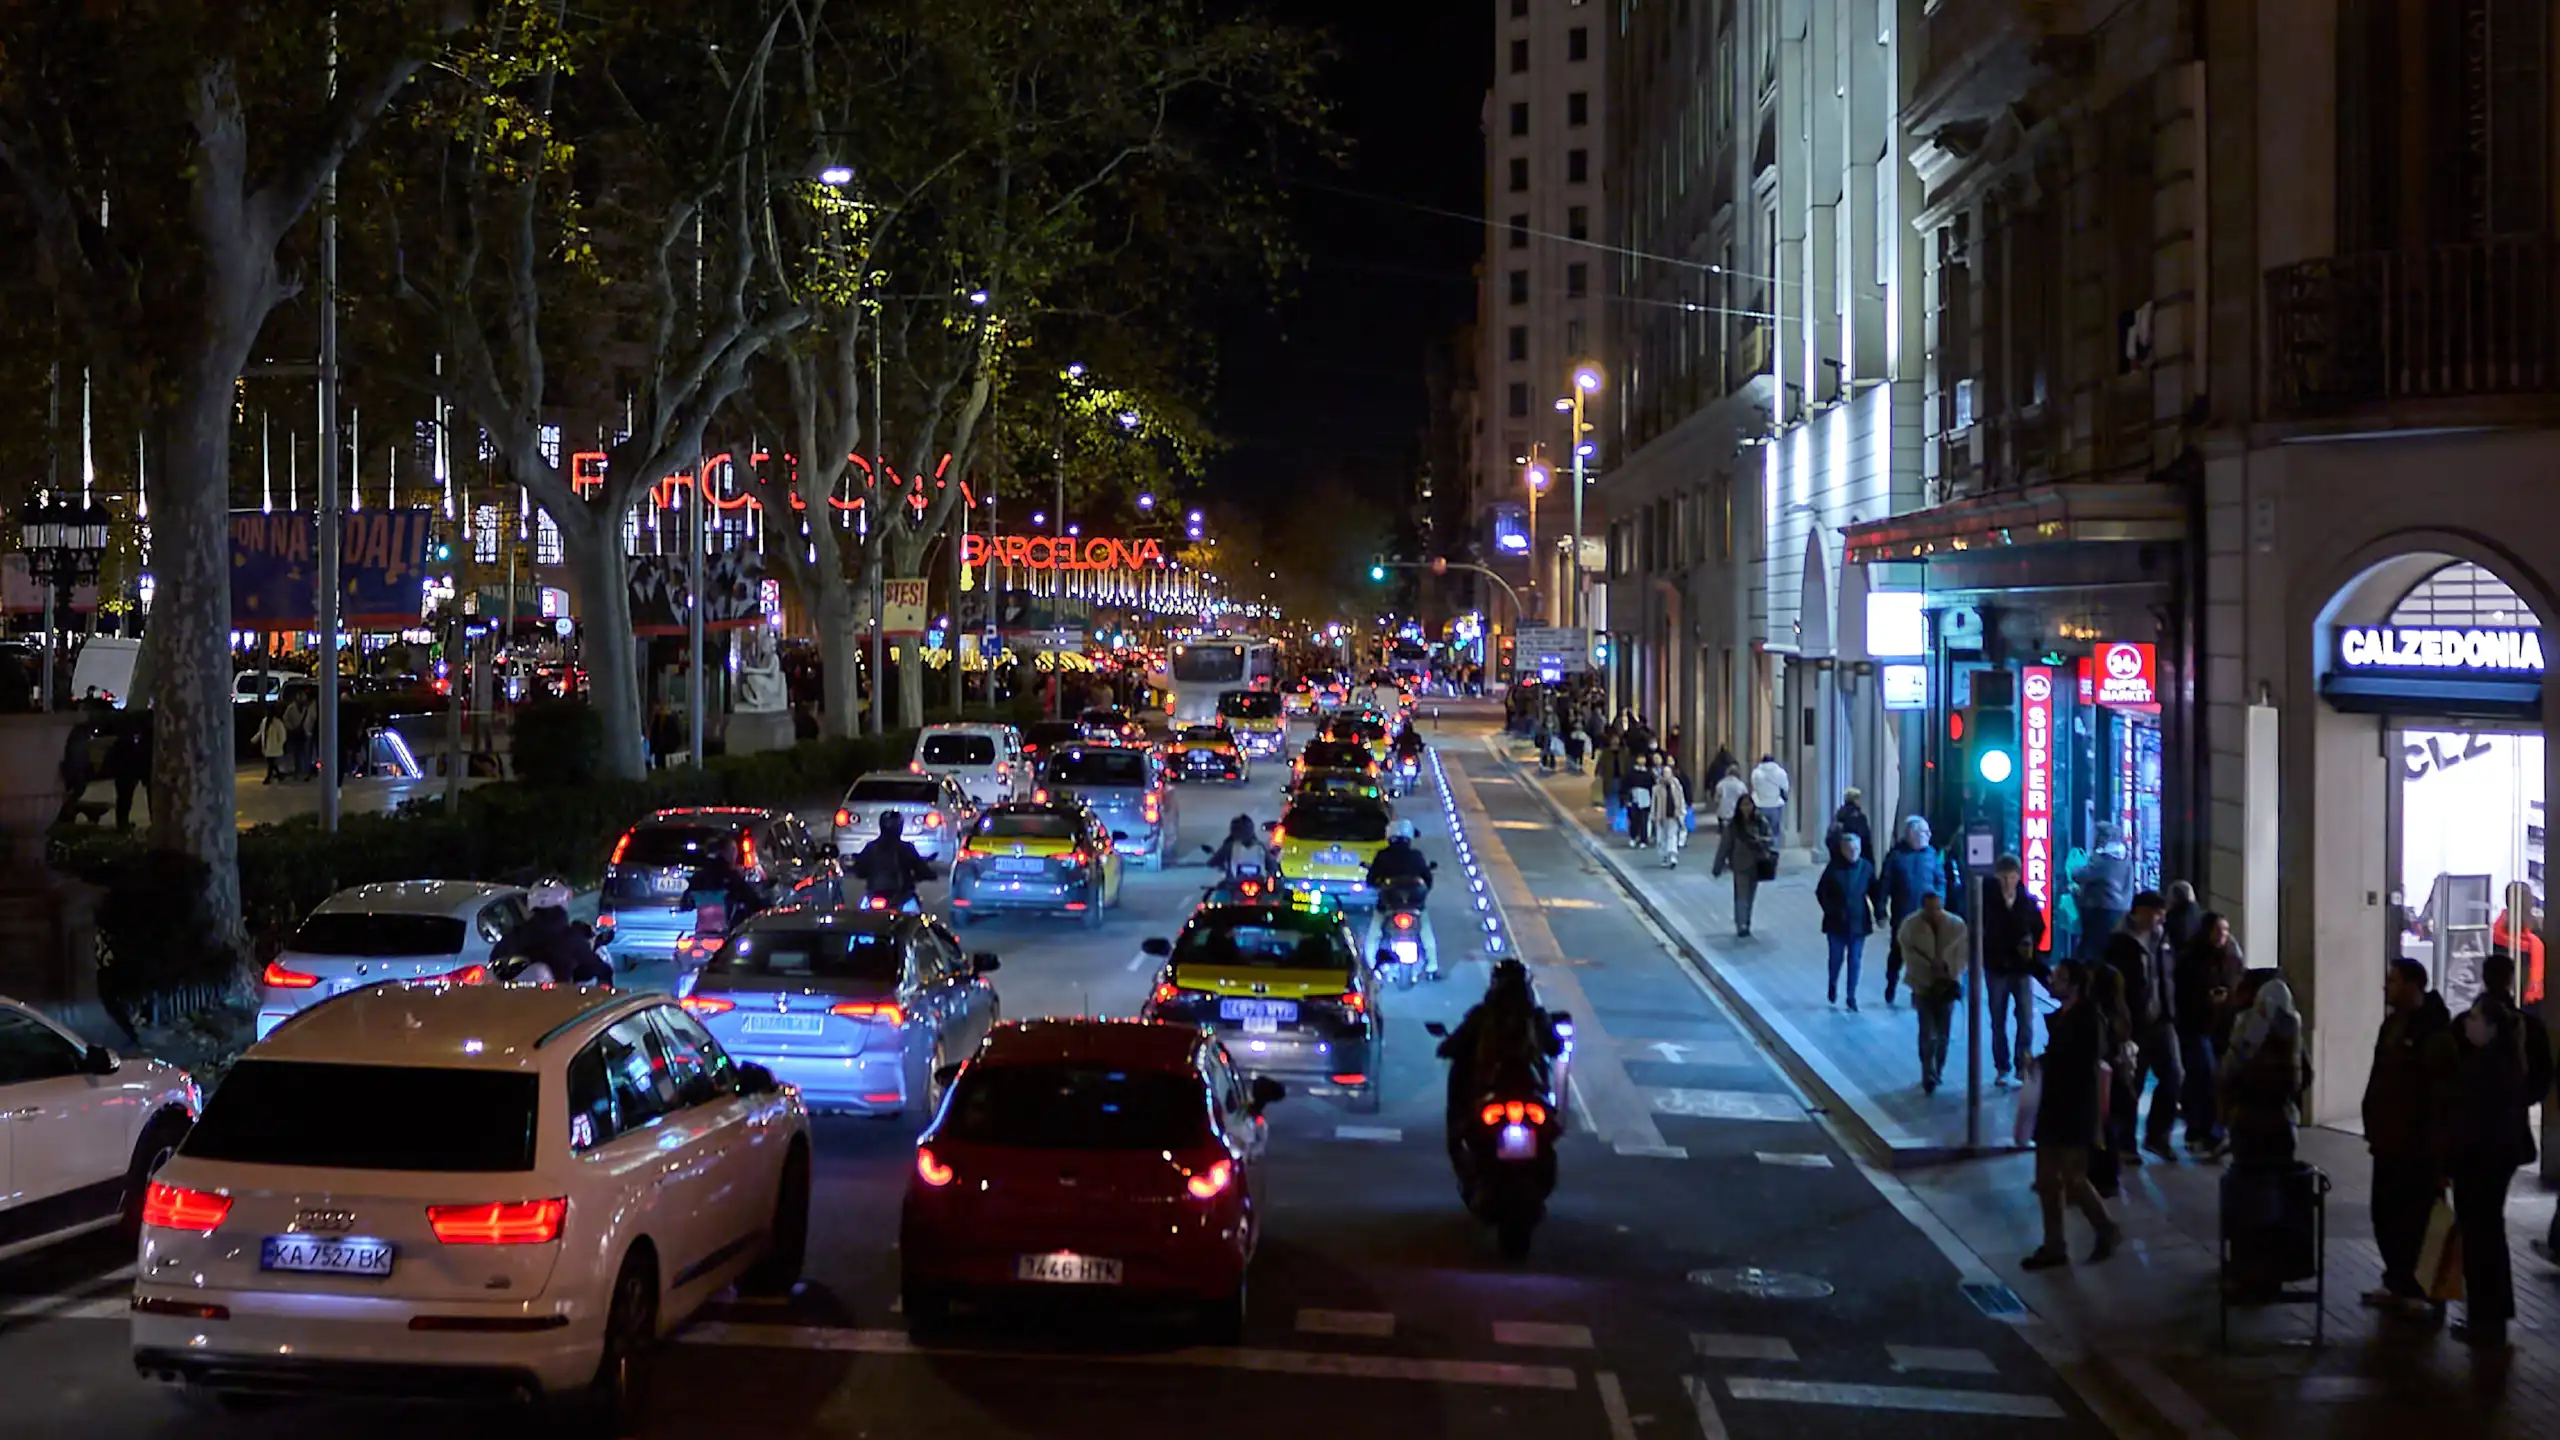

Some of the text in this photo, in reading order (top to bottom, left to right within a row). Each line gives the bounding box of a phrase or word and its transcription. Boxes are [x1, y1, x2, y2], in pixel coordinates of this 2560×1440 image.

[961, 534, 1167, 570] BARCELONA
[2342, 628, 2545, 669] CALZEDONIA
[2099, 689, 2152, 701] MARKET
[2027, 706, 2048, 909] SUPER MARK
[275, 1244, 388, 1269] KA 7527 BK
